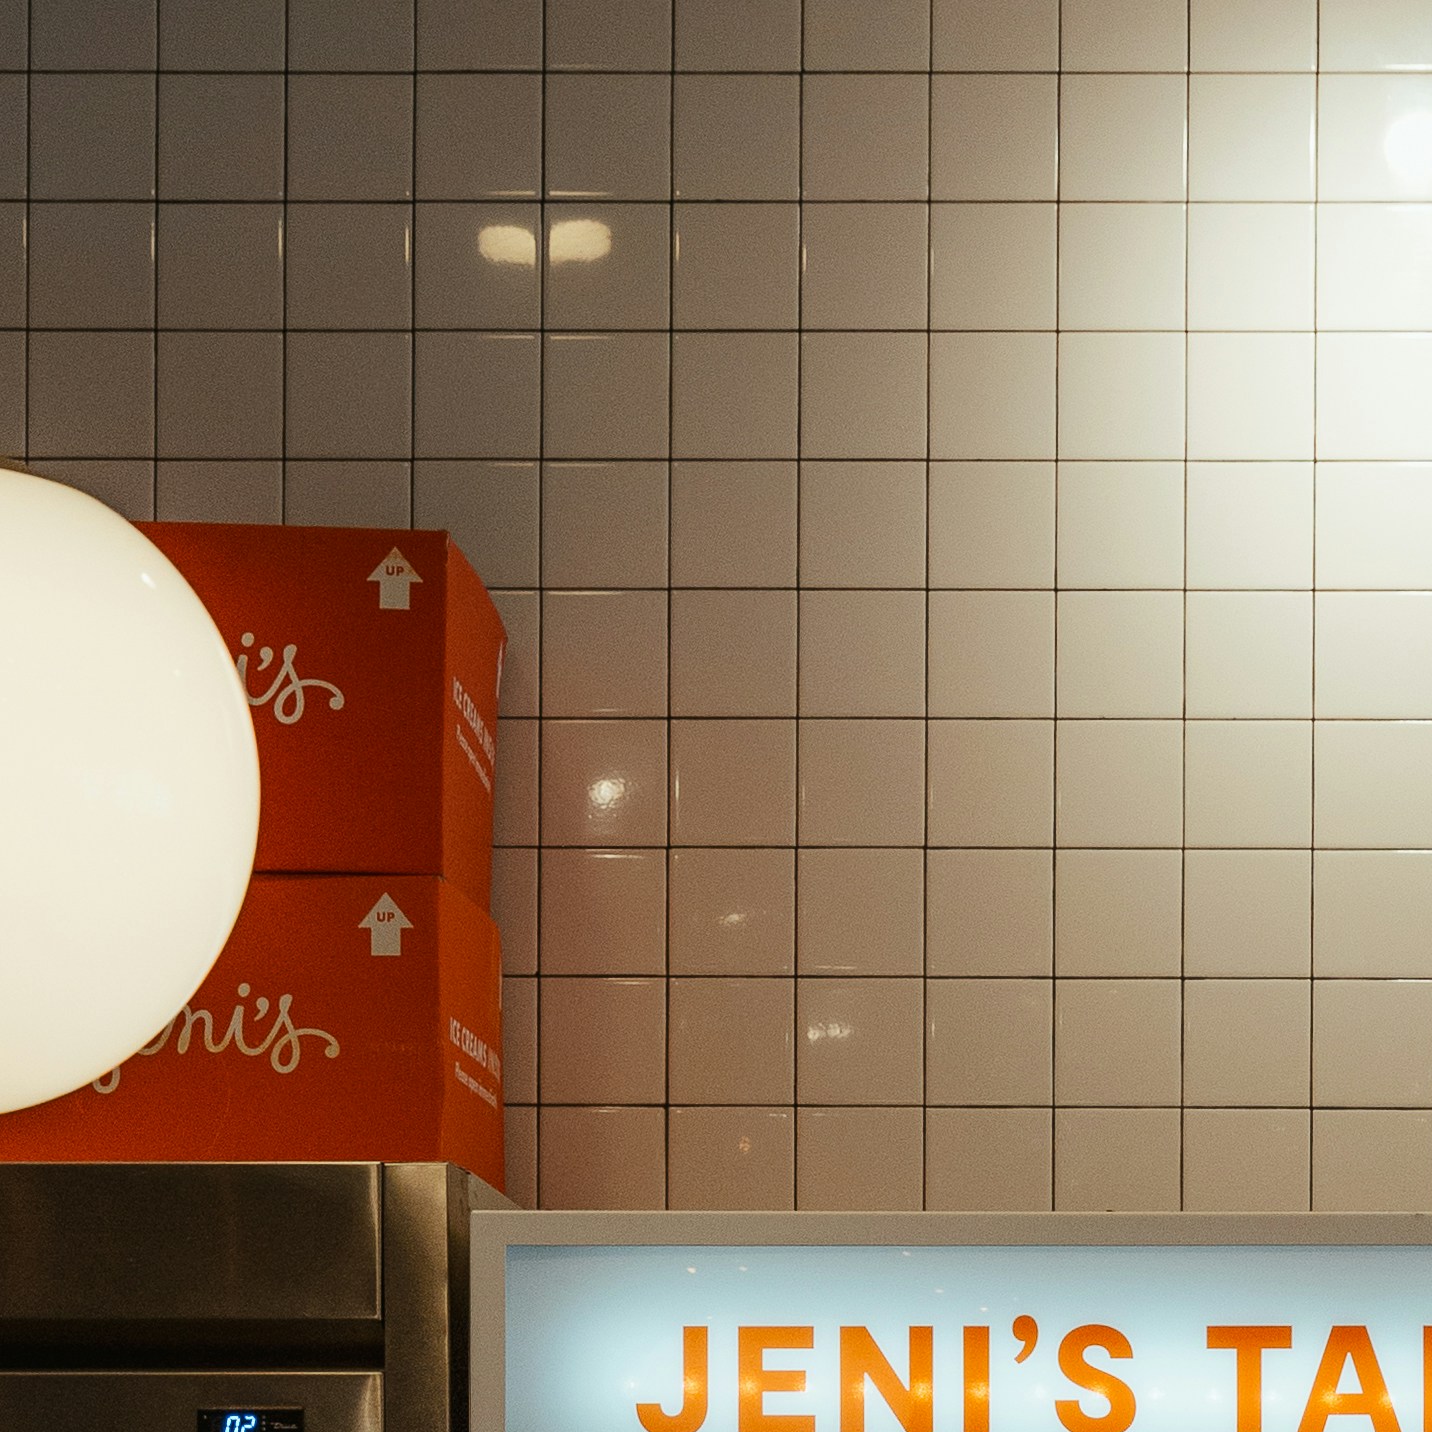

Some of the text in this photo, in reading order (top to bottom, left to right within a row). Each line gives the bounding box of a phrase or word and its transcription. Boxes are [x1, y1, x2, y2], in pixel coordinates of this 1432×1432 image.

[385, 565, 404, 577] UP
[236, 633, 344, 724] i's
[376, 911, 395, 922] UP
